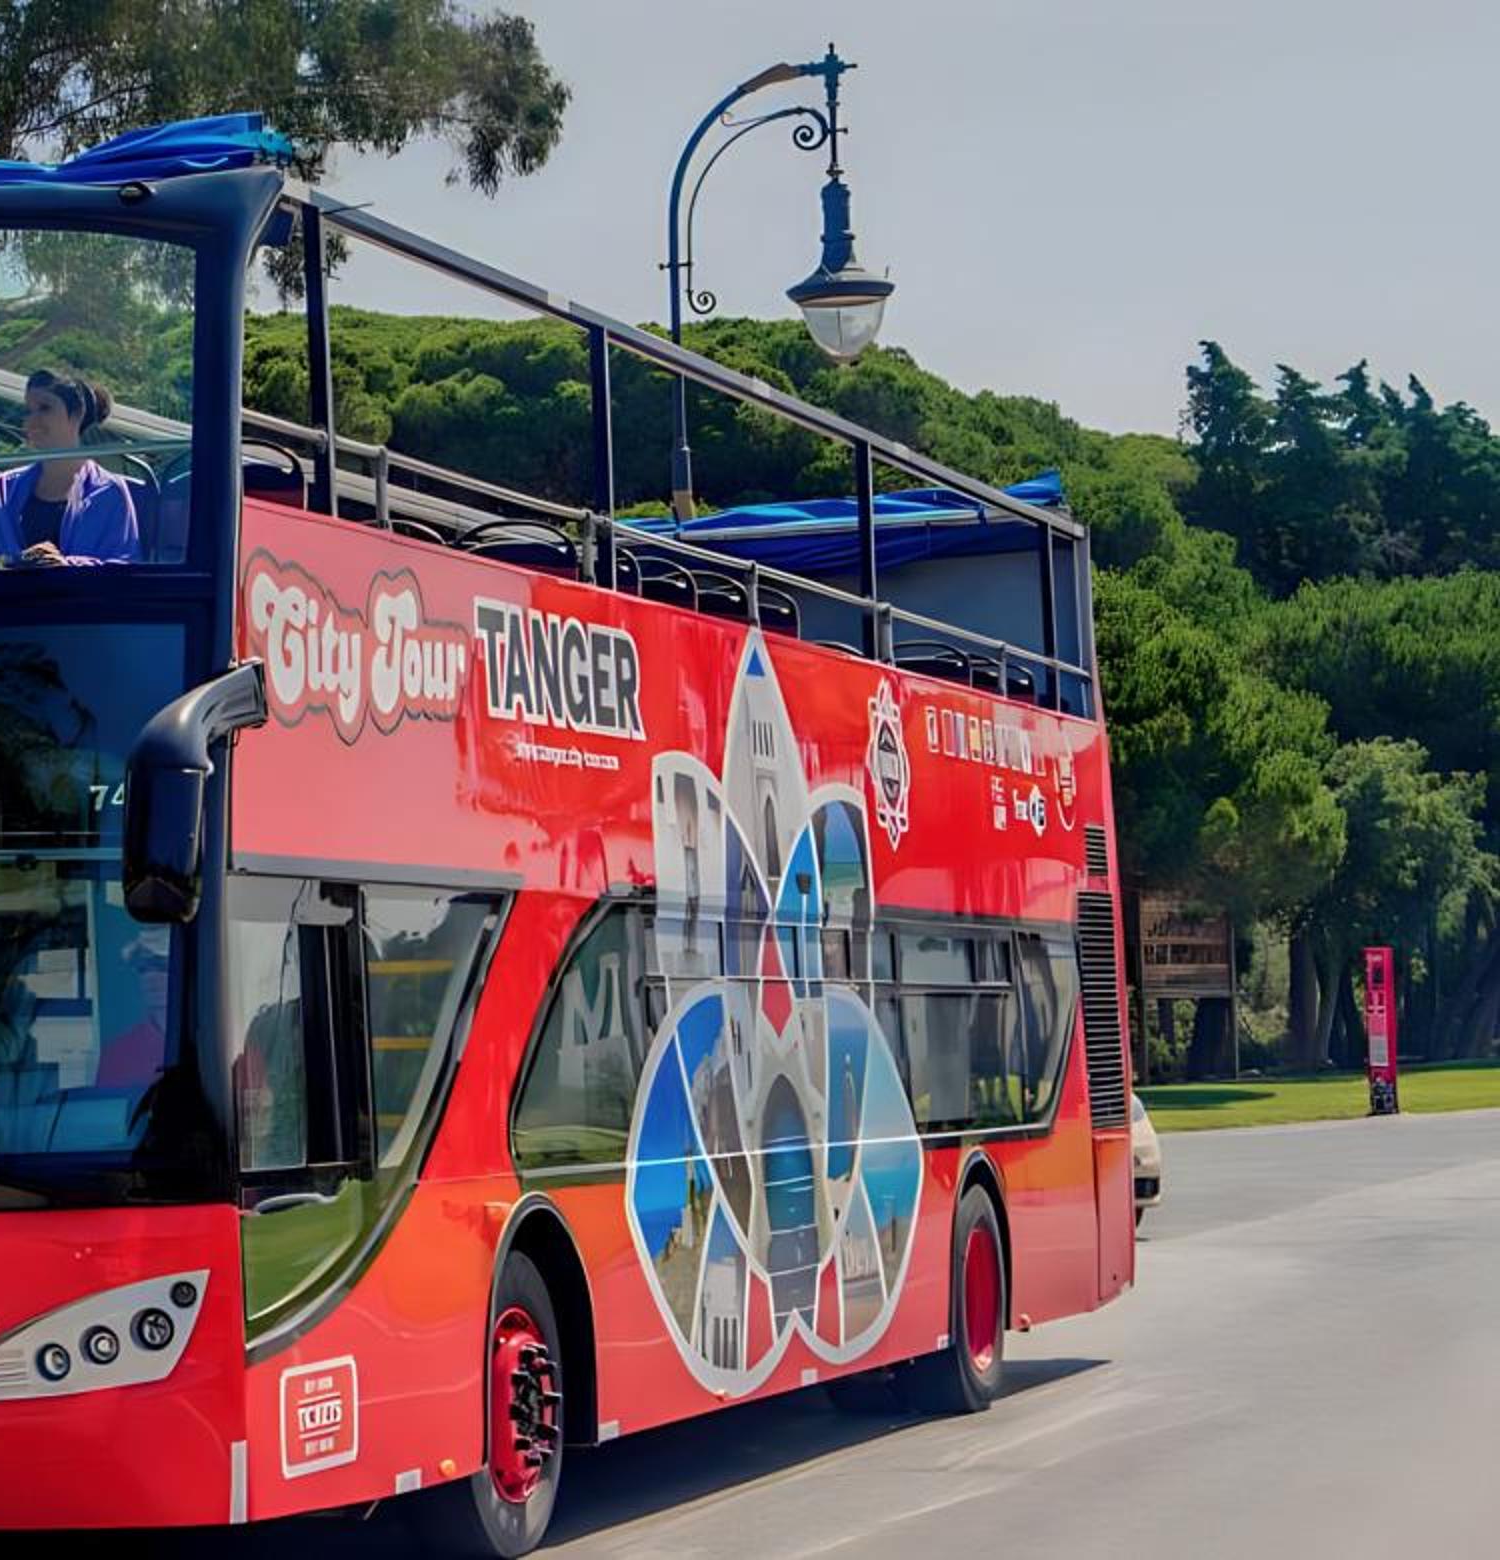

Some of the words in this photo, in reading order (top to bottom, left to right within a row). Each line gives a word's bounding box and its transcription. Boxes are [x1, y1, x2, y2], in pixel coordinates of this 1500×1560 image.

[252, 573, 360, 724] City
[371, 590, 465, 714] Tour
[475, 600, 644, 737] TANGER
